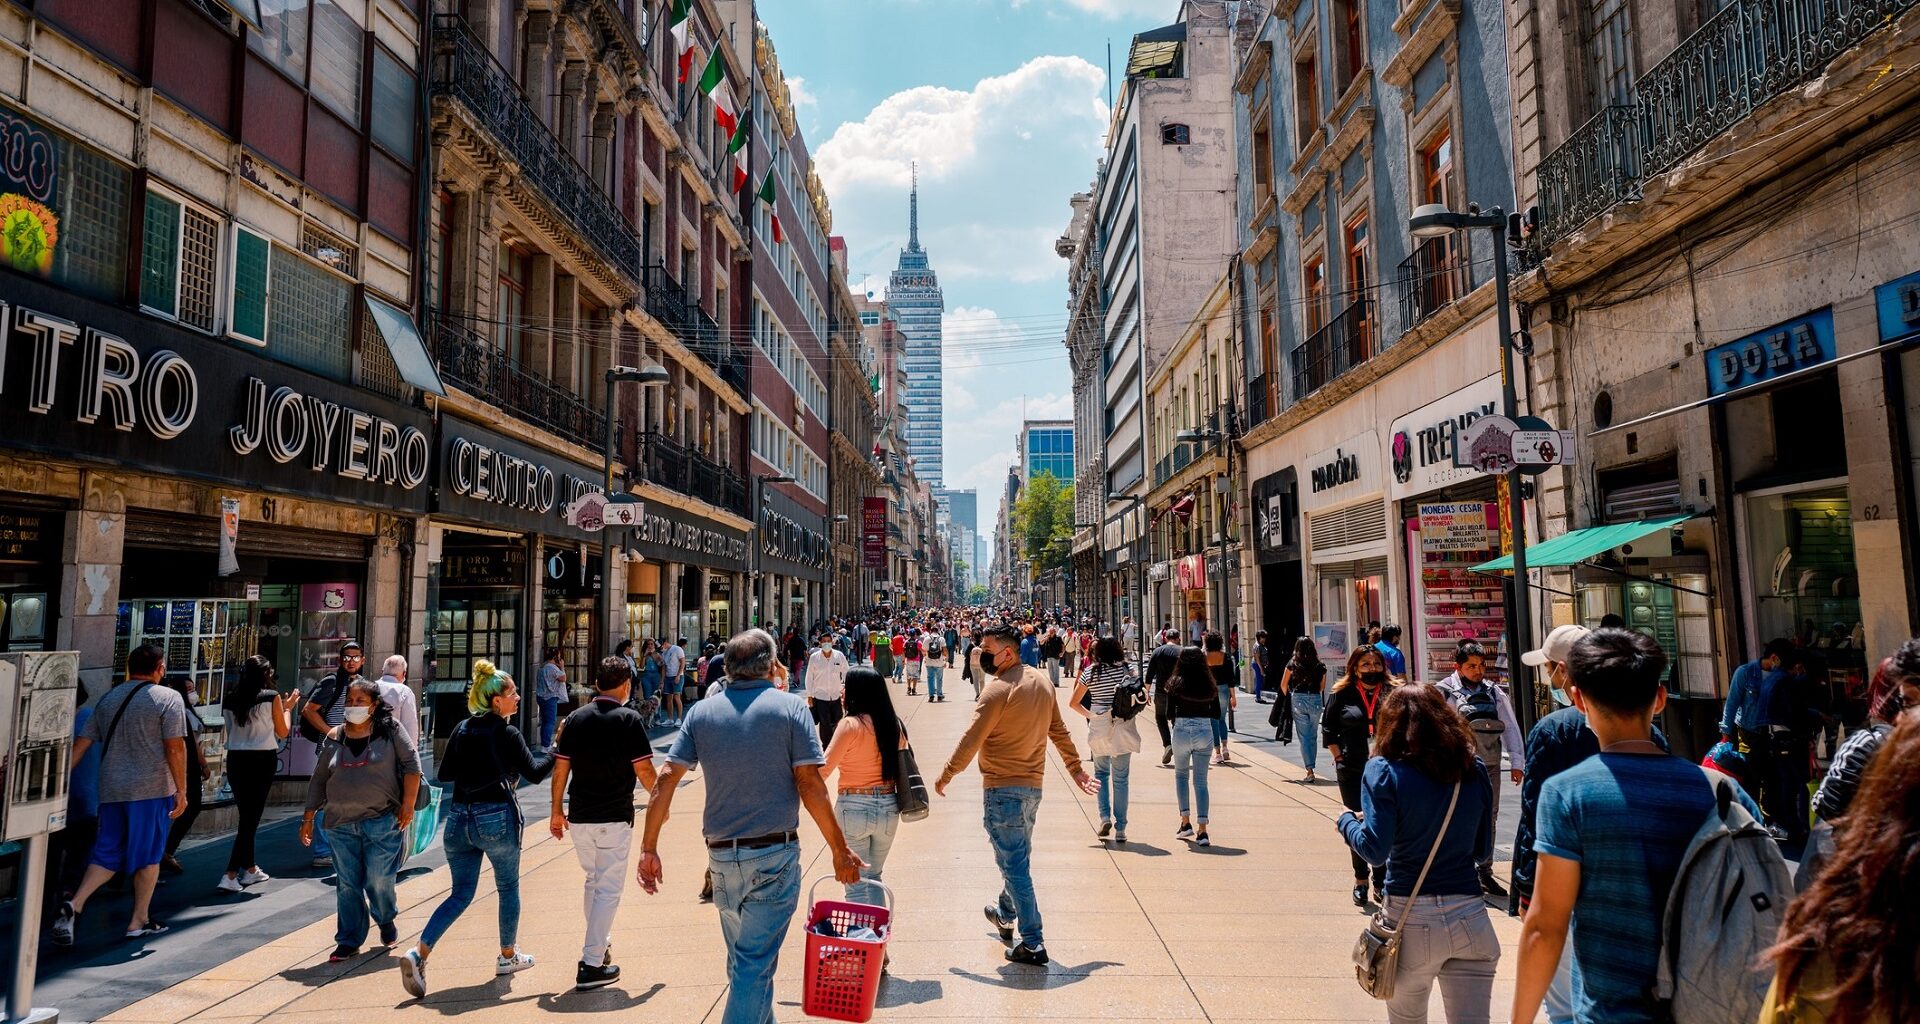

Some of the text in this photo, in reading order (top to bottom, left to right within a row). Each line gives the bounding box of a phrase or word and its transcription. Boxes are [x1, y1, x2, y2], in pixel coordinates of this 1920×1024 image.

[1719, 323, 1819, 384] DOXA
[0, 301, 430, 490] TRO JOYERO
[450, 436, 555, 514] CENTRO
[262, 497, 276, 522] 61
[1421, 504, 1482, 514] MONEDAS CESAR
[1864, 504, 1881, 520] 62
